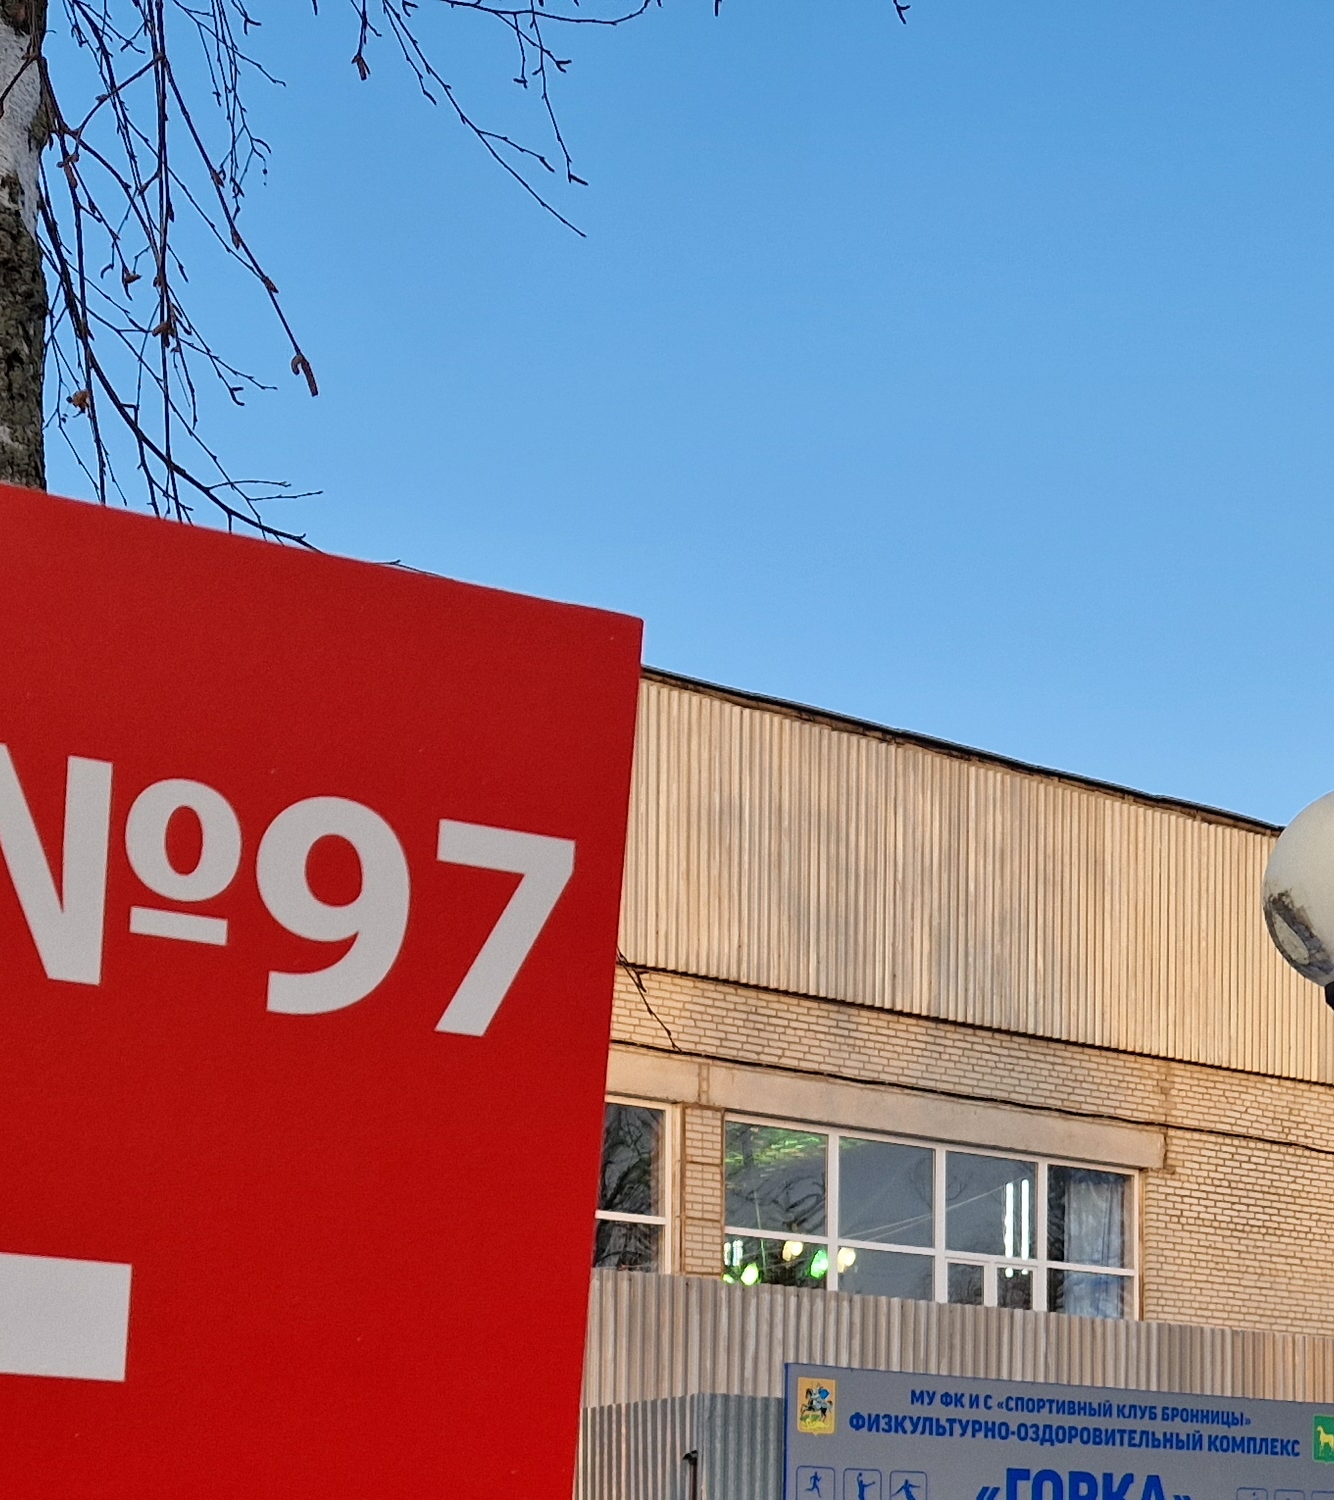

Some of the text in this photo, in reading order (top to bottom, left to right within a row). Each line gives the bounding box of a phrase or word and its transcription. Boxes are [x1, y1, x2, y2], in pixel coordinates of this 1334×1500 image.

[910, 1389, 1252, 1428] МУ ФК И С «СПОРТИВНЫЙ КЛУБ БРОННИЦЫ»
[849, 1412, 1301, 1457] ФИЗКУЛЬТУРНО-ОЗДОРОВИТЕЛЬНЫЙ КОМПЛЕКС
